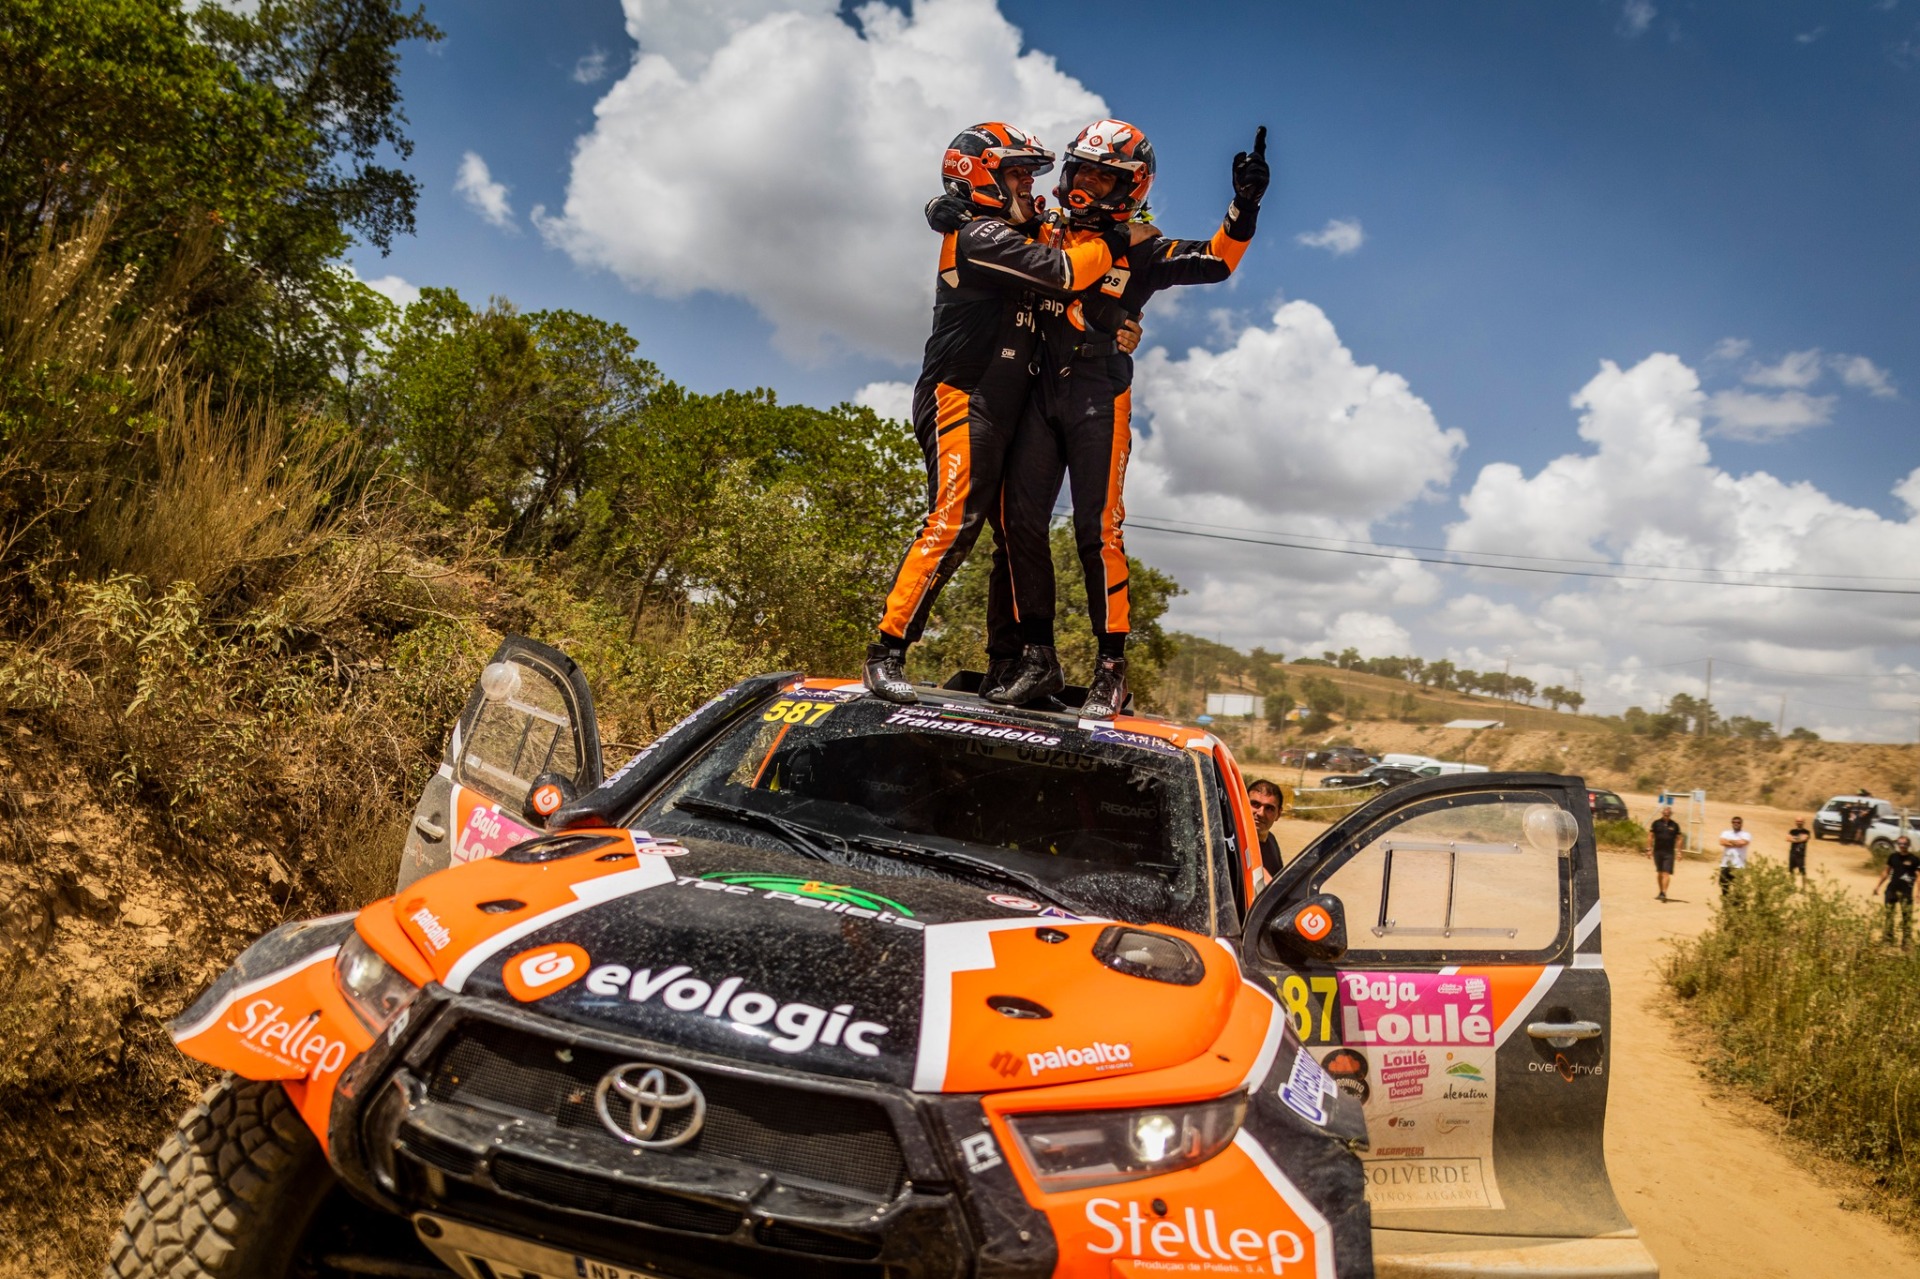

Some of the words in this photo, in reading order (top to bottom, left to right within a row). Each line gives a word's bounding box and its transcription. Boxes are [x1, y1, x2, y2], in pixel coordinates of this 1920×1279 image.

[763, 700, 836, 725] 587
[898, 707, 940, 718] TEAM
[885, 714, 1062, 746] Transfradelos
[470, 804, 501, 840] Baja
[1100, 800, 1158, 819] RECARO
[763, 890, 926, 930] Pellets
[410, 908, 451, 951] paloalto
[1341, 973, 1421, 1009] Baja
[585, 963, 890, 1057] evologic
[1268, 975, 1338, 1042] 87
[1343, 1003, 1492, 1043] Loulé
[226, 999, 347, 1082] Stellep
[1027, 1041, 1132, 1077] paloalto
[1096, 1062, 1134, 1071] NETWORKS
[1383, 1050, 1427, 1068] Loulé
[1382, 1068, 1427, 1082] Compromisso
[1395, 1080, 1411, 1088] com
[1390, 1084, 1421, 1097] Desporto
[1398, 1117, 1416, 1128] Faro
[1363, 1165, 1471, 1185] SOLVERDE
[1367, 1191, 1412, 1202] ASINOS
[1426, 1190, 1481, 1201] ALGARVE
[1085, 1197, 1305, 1276] Stellep
[1187, 1260, 1201, 1271] de
